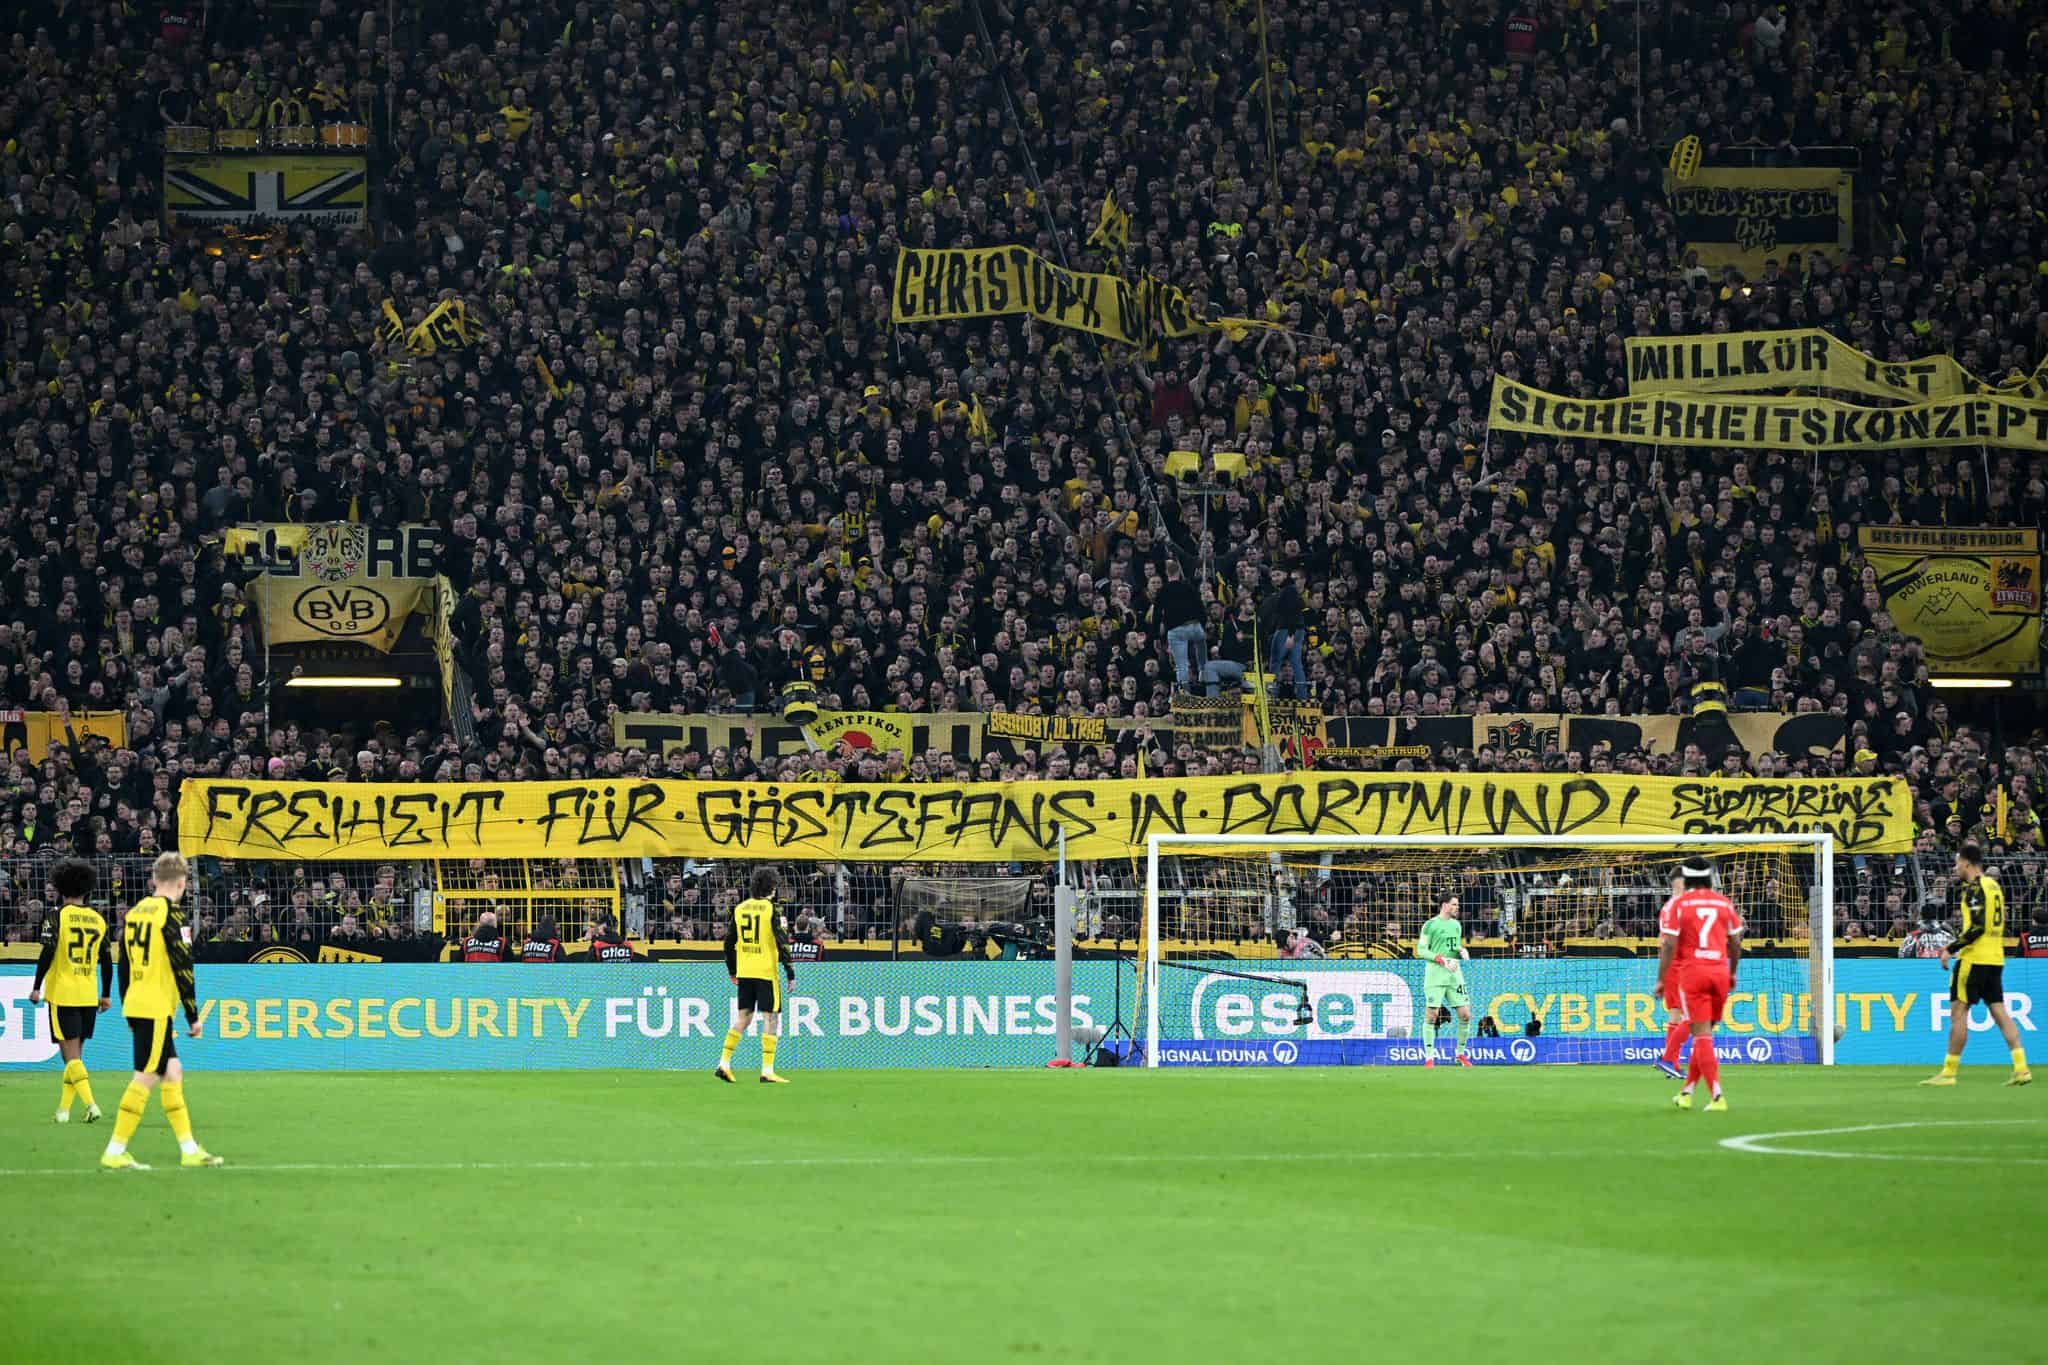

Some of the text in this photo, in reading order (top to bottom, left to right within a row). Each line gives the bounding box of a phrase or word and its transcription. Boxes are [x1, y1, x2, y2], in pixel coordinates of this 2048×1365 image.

[1500, 385, 2048, 446] SICHERHEITSKONZEPT
[1899, 571, 1979, 601] POWERLAND
[308, 589, 374, 620] BVB
[330, 620, 357, 631] 09
[1053, 716, 1105, 744] ULTRAS
[204, 786, 504, 849] FREIHEIT
[537, 783, 666, 848] FÜR
[697, 785, 1096, 849] GÄSTEFANS
[741, 914, 761, 944] 21
[1696, 907, 1719, 948] 7
[68, 927, 101, 965] 27
[172, 997, 592, 1038] YBERSECURITY
[606, 986, 716, 1038] FÜR
[1217, 1049, 1268, 1062] IDUNA
